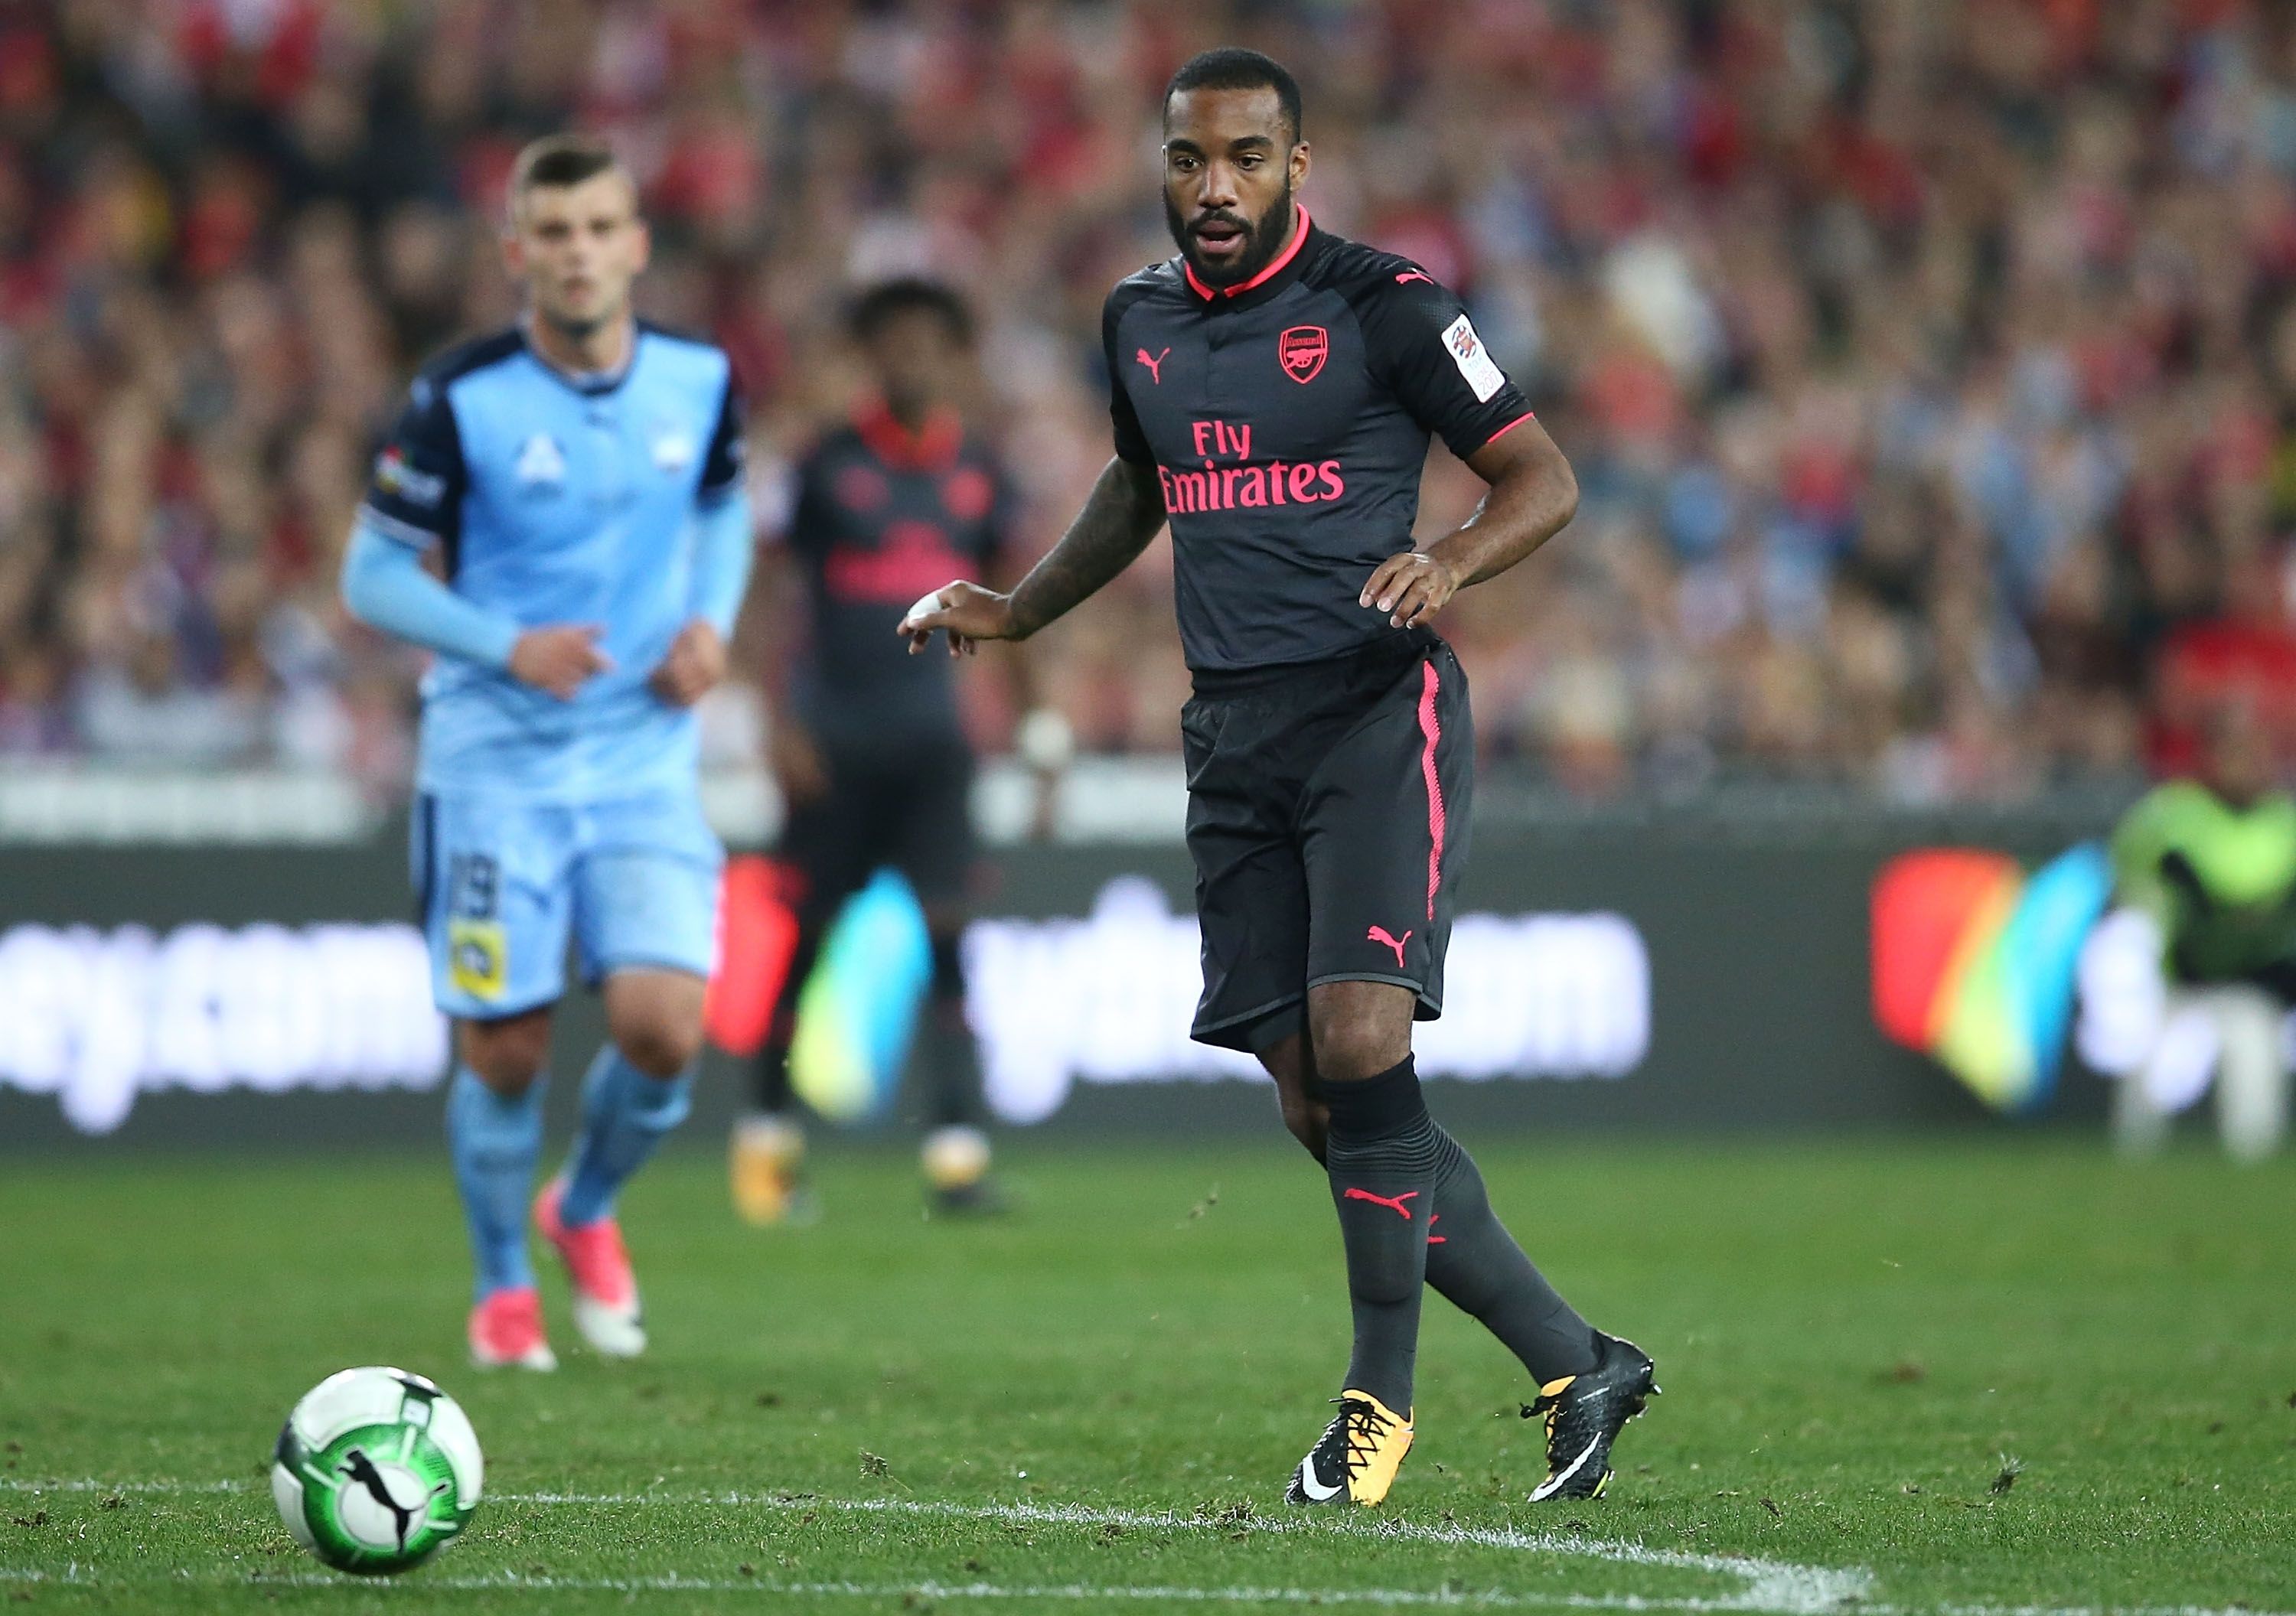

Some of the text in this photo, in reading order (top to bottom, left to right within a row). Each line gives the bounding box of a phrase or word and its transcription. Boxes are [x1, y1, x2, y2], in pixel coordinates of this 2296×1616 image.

[1478, 370, 1500, 396] 2017
[1192, 420, 1251, 461] Fly
[1157, 459, 1345, 513] Emirates
